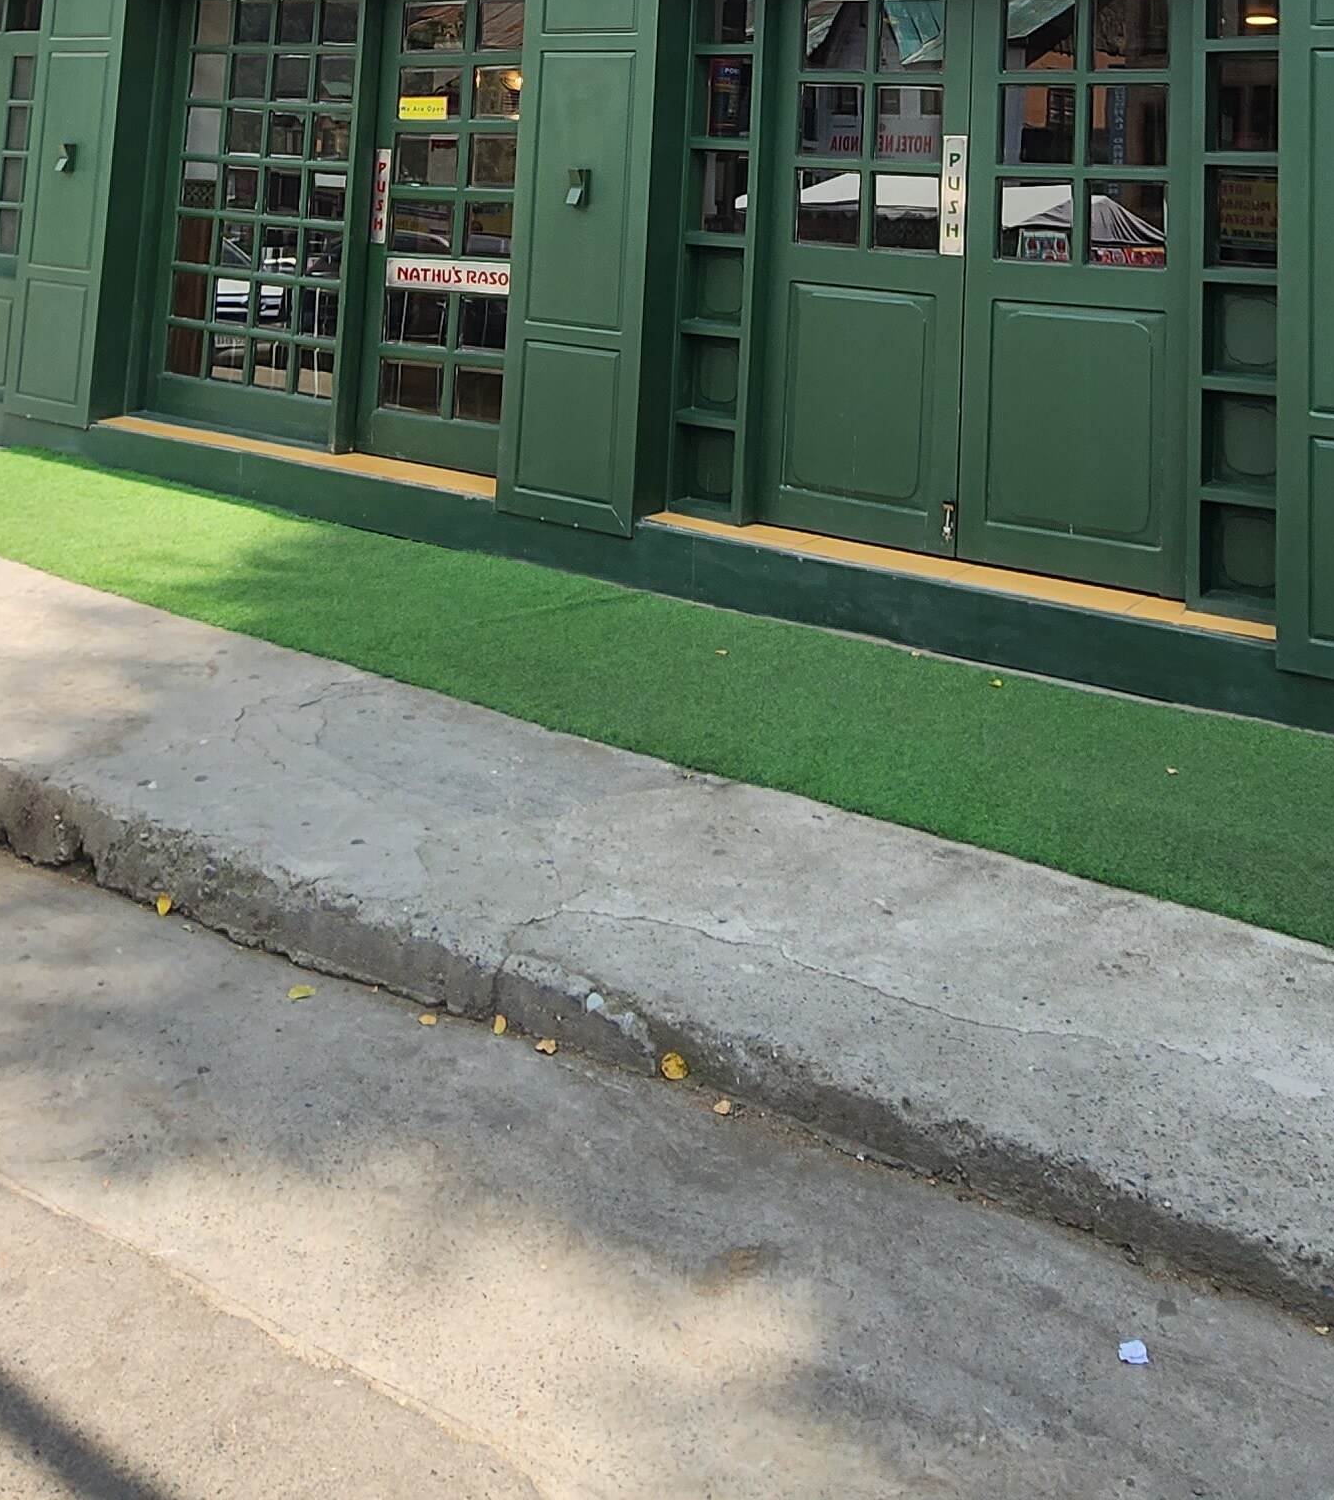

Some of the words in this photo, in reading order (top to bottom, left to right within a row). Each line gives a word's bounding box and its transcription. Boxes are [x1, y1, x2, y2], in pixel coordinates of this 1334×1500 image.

[373, 161, 387, 231] PUSH
[946, 152, 961, 238] PUSH
[397, 266, 462, 284] NATHU'S
[467, 270, 509, 286] RASO
